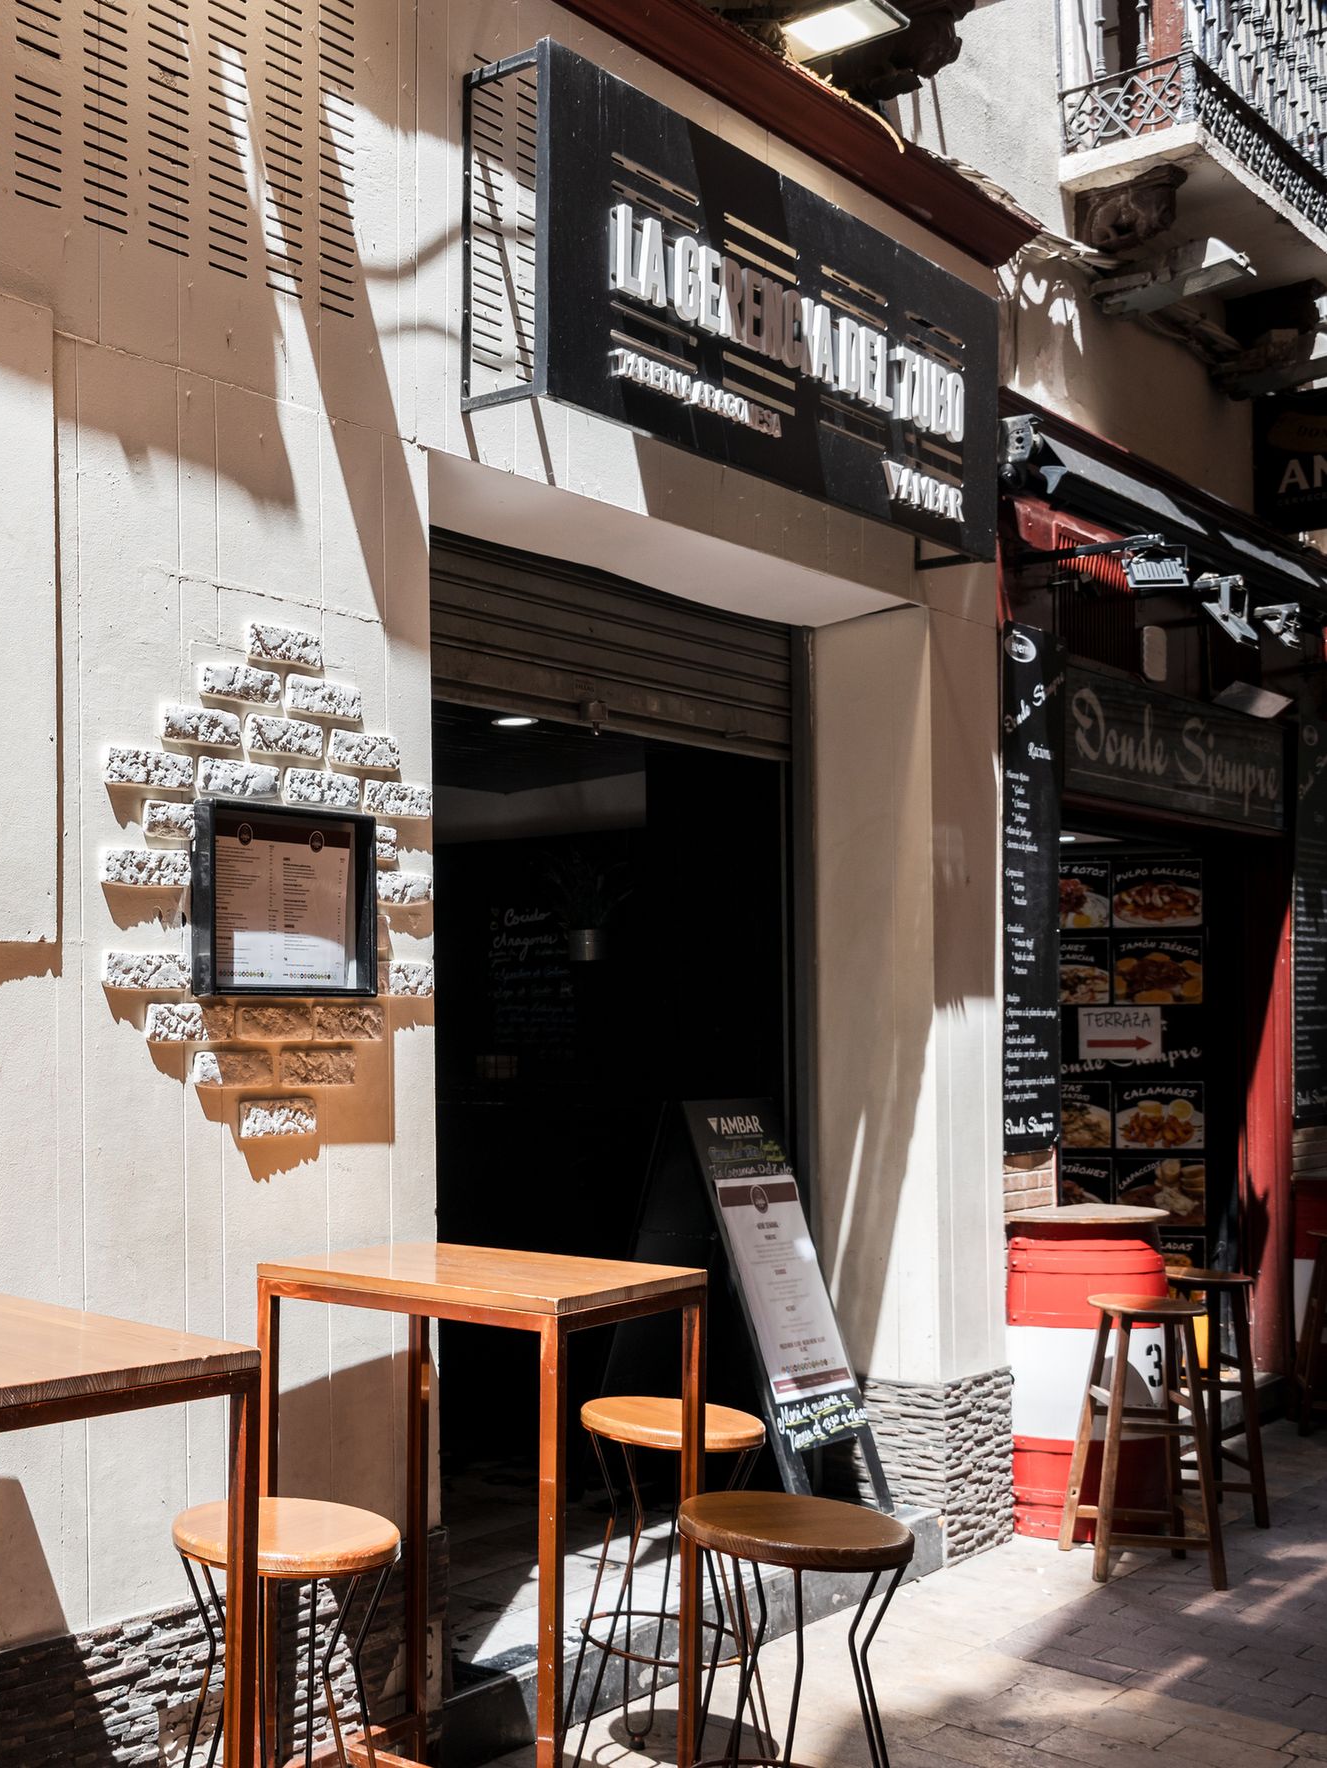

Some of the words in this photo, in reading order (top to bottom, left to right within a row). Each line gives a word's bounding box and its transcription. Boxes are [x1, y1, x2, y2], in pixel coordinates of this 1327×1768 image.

[610, 203, 668, 309] LA
[674, 235, 835, 385] GERENCIA
[838, 316, 894, 413] DEL
[893, 345, 966, 444] TUBO
[608, 347, 694, 401] TABERNA
[689, 380, 782, 438] ARAGONESA
[898, 467, 965, 523] AMBAR
[1071, 686, 1169, 777] Donde
[1174, 715, 1281, 817] Siempre
[1115, 866, 1149, 883] PULPO
[1151, 866, 1200, 880] GALLEGO
[1083, 1010, 1152, 1029] TERRAZA
[1123, 1084, 1199, 1101] CALAMARES
[720, 1115, 765, 1136] AMBAR
[1061, 1162, 1110, 1179] PIÑONES
[1146, 1343, 1164, 1388] 3
